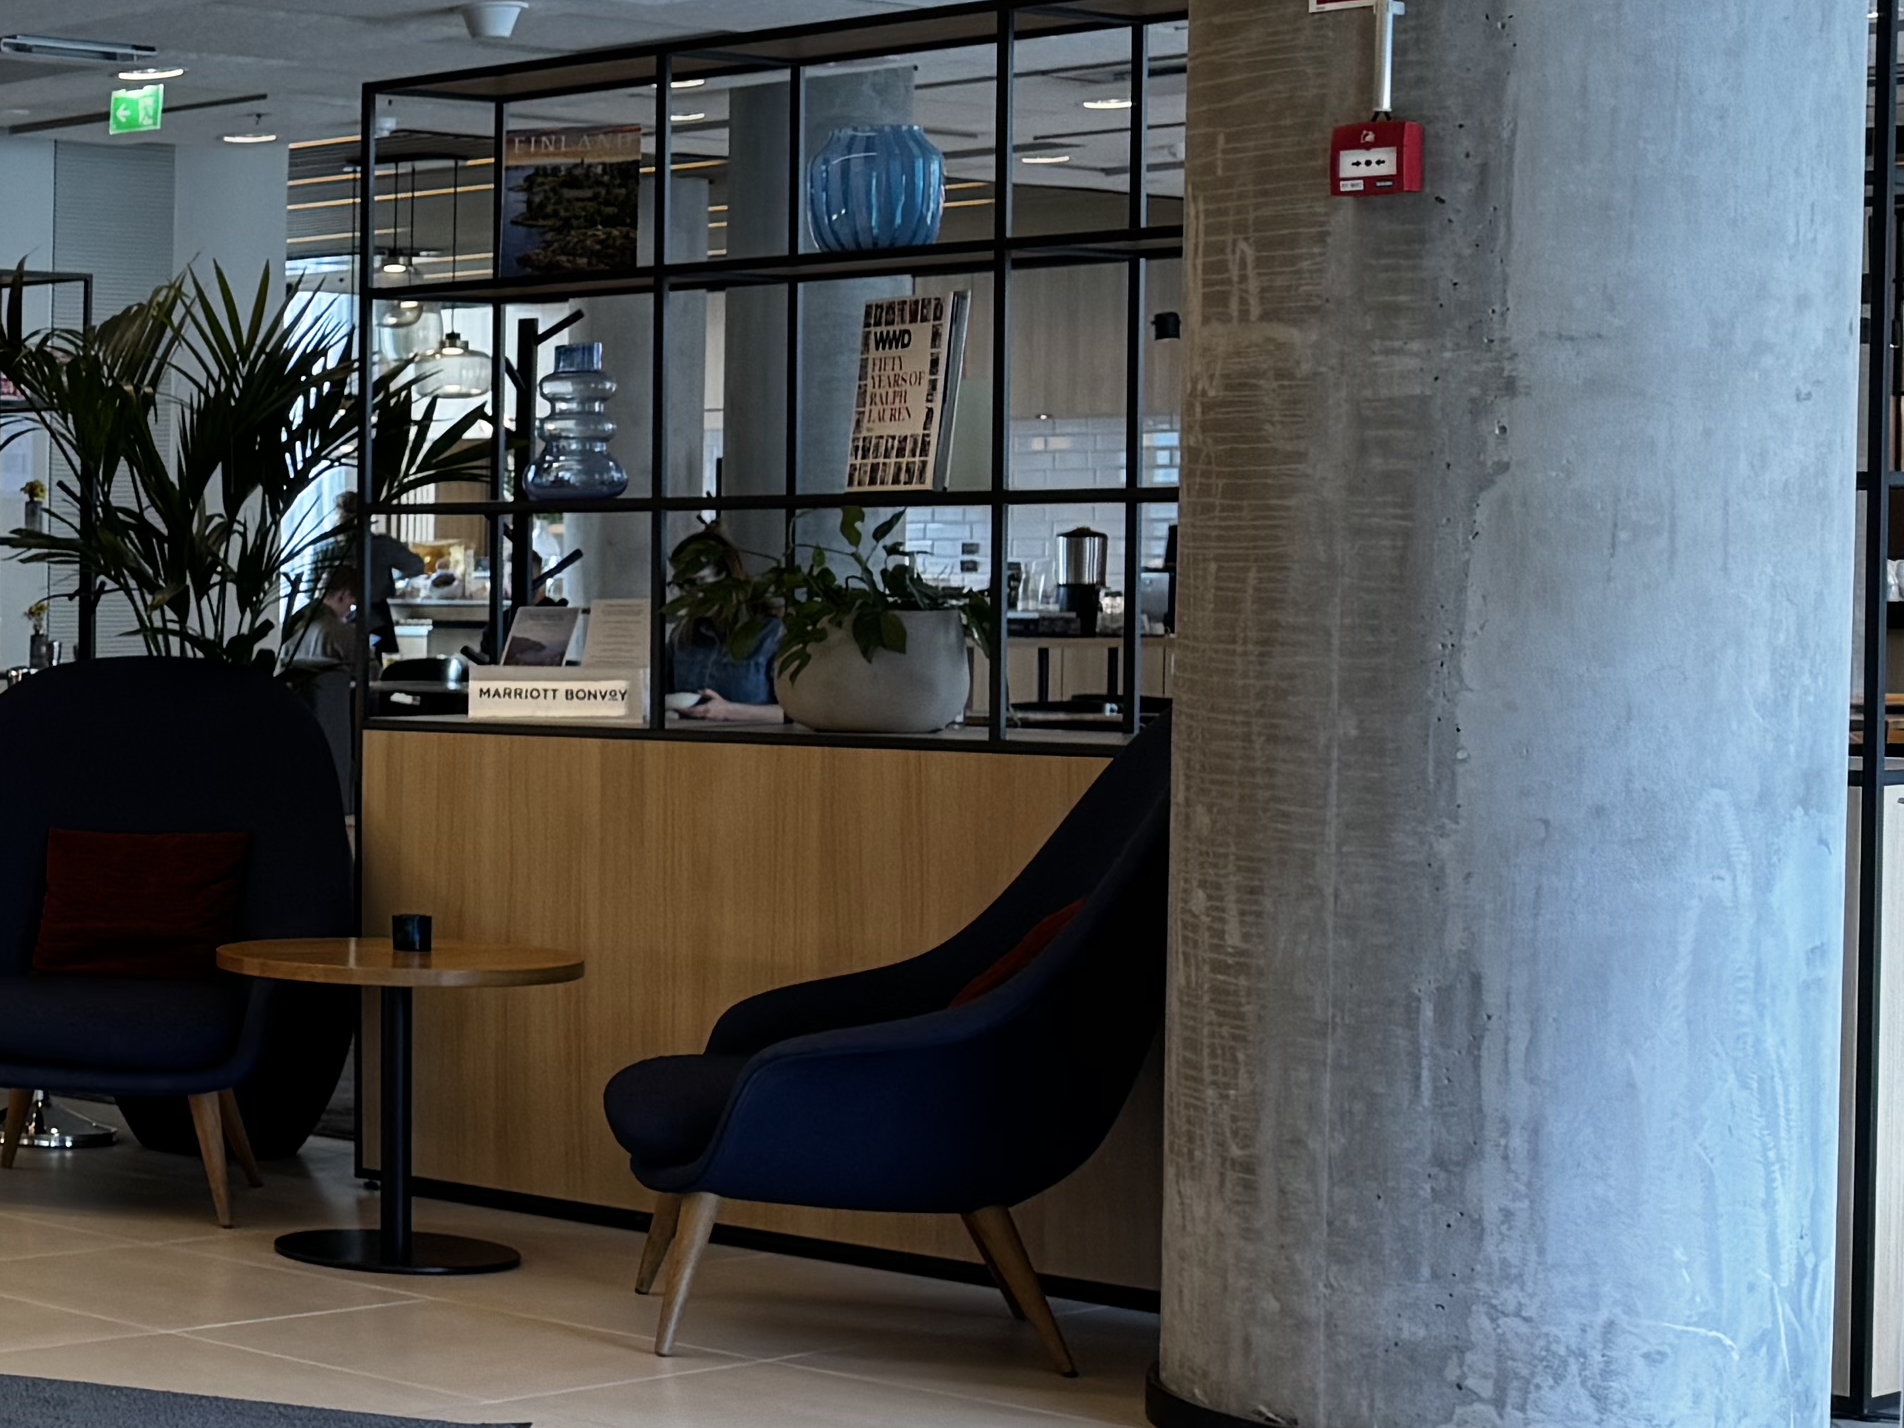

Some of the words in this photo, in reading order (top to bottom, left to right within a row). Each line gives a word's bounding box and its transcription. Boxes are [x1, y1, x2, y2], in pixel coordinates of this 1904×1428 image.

[514, 133, 632, 154] FINLAND
[873, 329, 912, 351] WWD
[871, 355, 904, 373] FIFTY
[869, 373, 908, 389] YEARS
[909, 371, 926, 387] OF
[869, 389, 908, 406] RALPH
[867, 406, 912, 423] LAUREN
[479, 687, 560, 702] MARRIOTT
[564, 688, 628, 702] BONVOY
